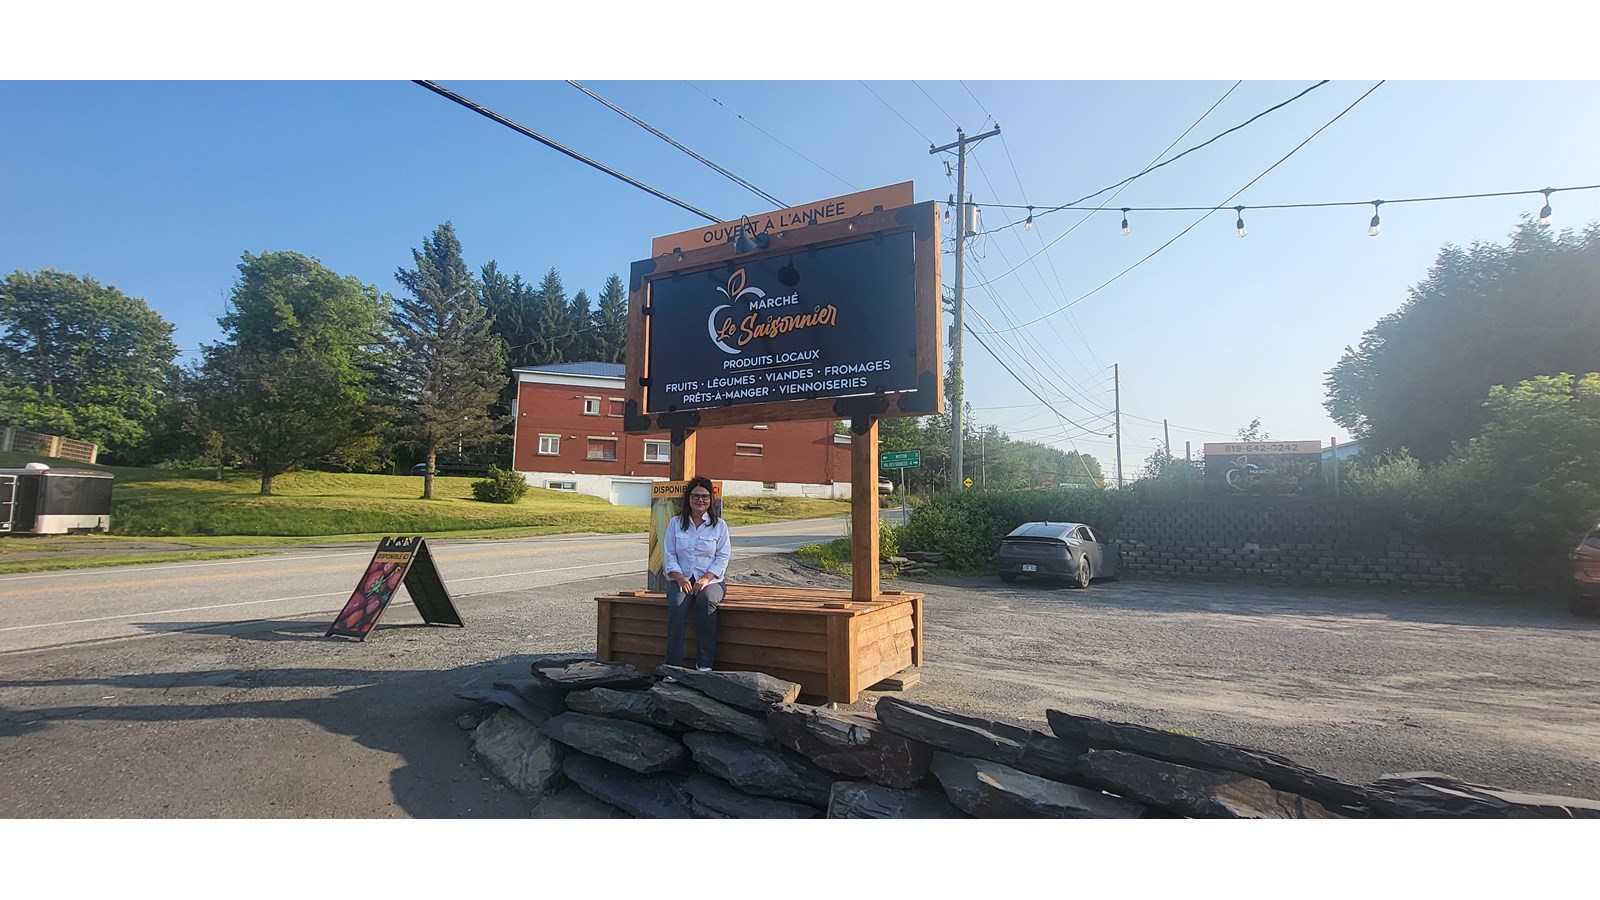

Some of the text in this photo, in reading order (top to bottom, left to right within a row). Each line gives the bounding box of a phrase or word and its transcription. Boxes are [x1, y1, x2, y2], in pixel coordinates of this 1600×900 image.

[703, 202, 846, 243] OUVERT À L'ANNÉE
[749, 291, 799, 311] MARCHÉ
[717, 304, 838, 346] Le Saisonnier
[723, 349, 820, 370] PRODUITS LOCAUX
[665, 360, 891, 393] FRUITS LÉGUMES VIANDES FROMAGES
[683, 376, 868, 404] PRÊTS-À-MANGER VIENNOISERIES
[1225, 444, 1298, 453] 819-642-0242
